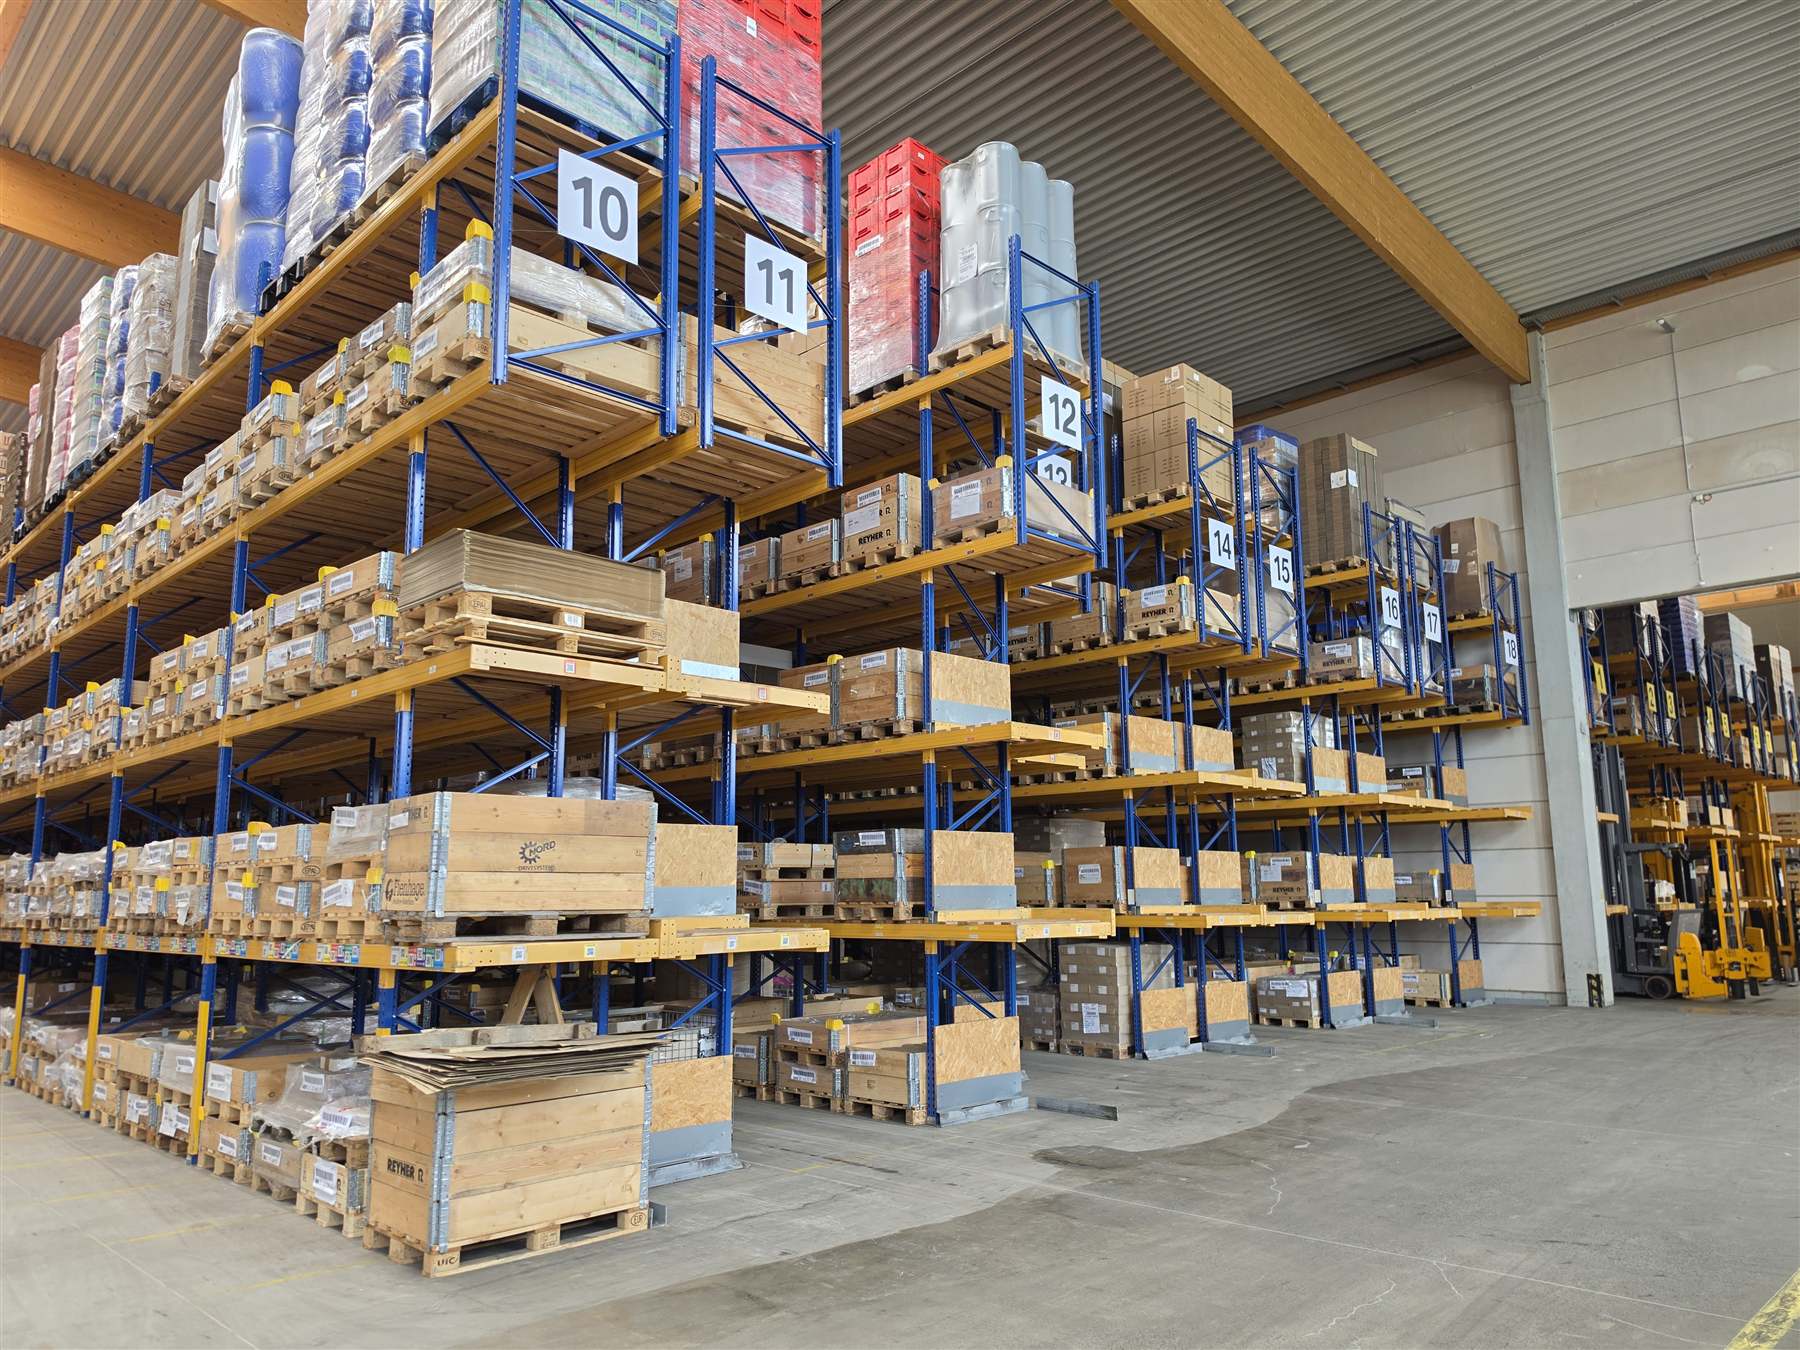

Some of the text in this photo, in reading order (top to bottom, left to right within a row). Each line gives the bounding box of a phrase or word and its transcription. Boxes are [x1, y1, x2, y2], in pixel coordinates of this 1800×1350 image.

[572, 175, 629, 242] 10
[757, 258, 794, 315] 11
[1048, 392, 1077, 438] 12
[1213, 529, 1232, 560] 14
[1273, 555, 1290, 583] 15
[1385, 595, 1399, 620] 16
[1427, 611, 1438, 634] 17
[1506, 639, 1517, 659] 18
[1597, 667, 1604, 690] 1
[1648, 686, 1655, 708] 2
[1668, 694, 1674, 714] 3
[528, 840, 557, 857] NORD
[387, 1158, 415, 1181] REYHER
